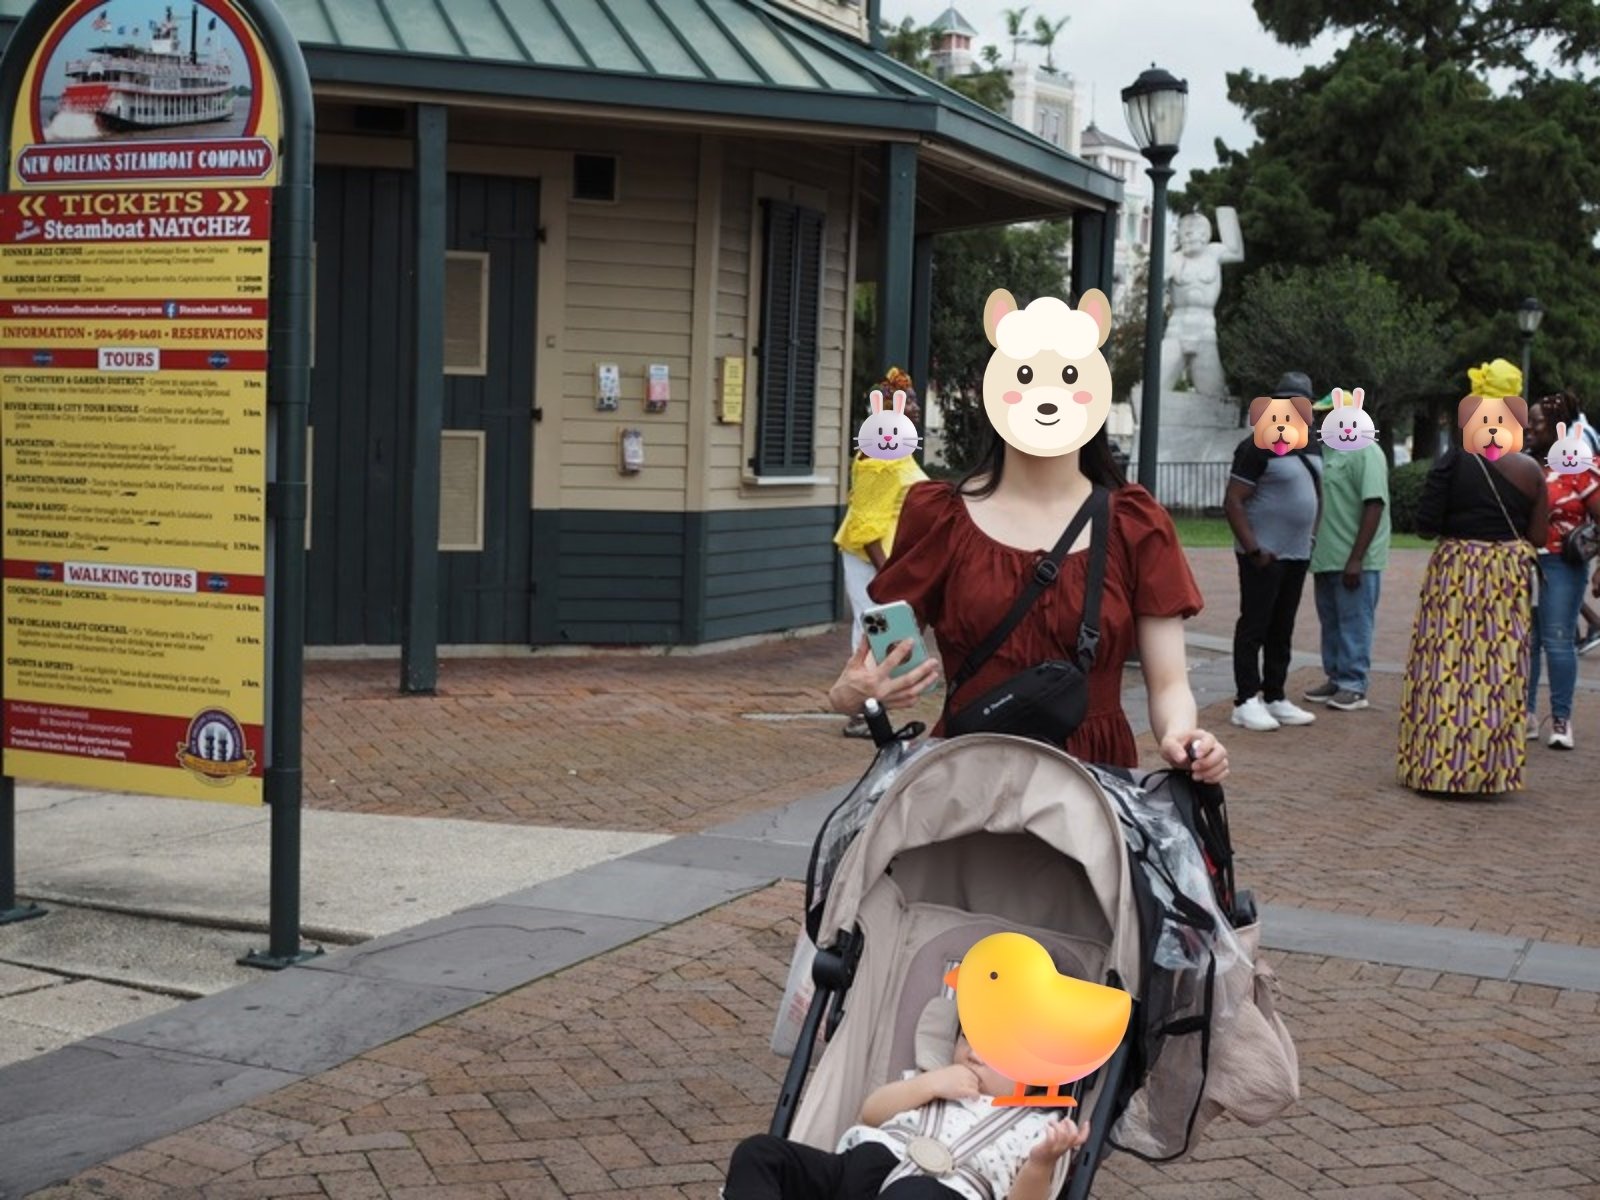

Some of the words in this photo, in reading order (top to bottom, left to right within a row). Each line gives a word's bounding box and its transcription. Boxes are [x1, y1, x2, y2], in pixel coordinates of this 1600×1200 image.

[22, 156, 50, 174] NEW
[53, 153, 112, 172] ORLEANS
[115, 150, 194, 170] STEAMBOAT
[198, 149, 267, 168] COMPANY
[59, 191, 204, 216] TICKETS
[44, 218, 144, 240] Steamboat
[150, 216, 251, 237] NATCHEZ
[12, 304, 29, 314] Visit
[179, 304, 218, 314] Steamboat
[222, 304, 252, 314] Natchez
[2, 326, 85, 339] INFORMATION
[95, 328, 162, 340] 504-569-1401
[171, 326, 263, 340] RESERVATIONS
[104, 351, 154, 367] TOURS
[24, 376, 64, 385] CEMETERY
[73, 376, 105, 385] GARDEN
[107, 377, 144, 386] DISTRICT
[4, 402, 26, 411] RIVER
[28, 402, 55, 411] CRUISE
[63, 403, 82, 412] CITY
[83, 403, 105, 413] TOUR
[107, 404, 138, 413] BUNDLE
[5, 438, 54, 448] PLANTATION
[6, 501, 34, 511] SWAMP
[42, 502, 68, 513] BAYOU
[6, 528, 39, 538] AIRBOAT
[41, 529, 70, 540] SWAMP
[69, 566, 139, 586] WALKING
[142, 570, 193, 589] TOURS
[7, 585, 40, 596] COOKING
[71, 589, 108, 601] COCKTAIL
[8, 616, 24, 626] NEW
[26, 618, 61, 630] ORLEANS
[63, 620, 87, 632] CRAFT
[89, 622, 128, 635] COCKTAIL
[7, 657, 37, 668] GHOSTS
[45, 660, 73, 672] SPIRITS
